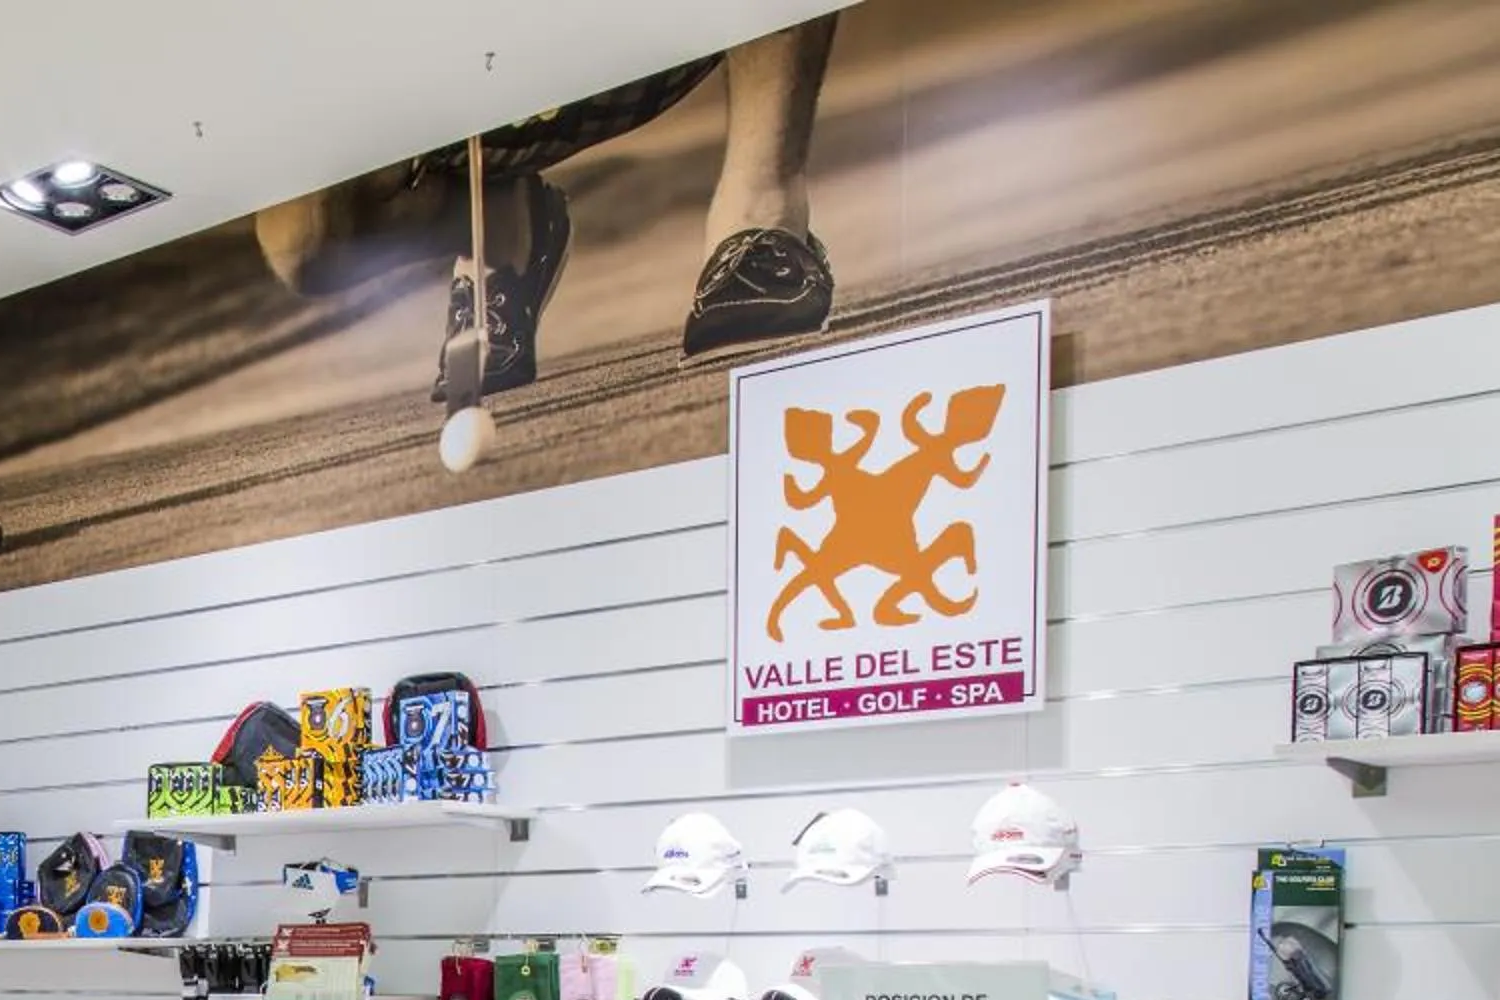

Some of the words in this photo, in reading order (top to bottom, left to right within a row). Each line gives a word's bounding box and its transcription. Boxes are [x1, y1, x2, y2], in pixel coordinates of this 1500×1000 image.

[744, 656, 844, 690] VALLE
[854, 649, 921, 680] DEL
[931, 637, 1023, 672] ESTE
[757, 698, 836, 723] HOTEL
[857, 688, 927, 715] GOLF
[949, 681, 1004, 706] SPA
